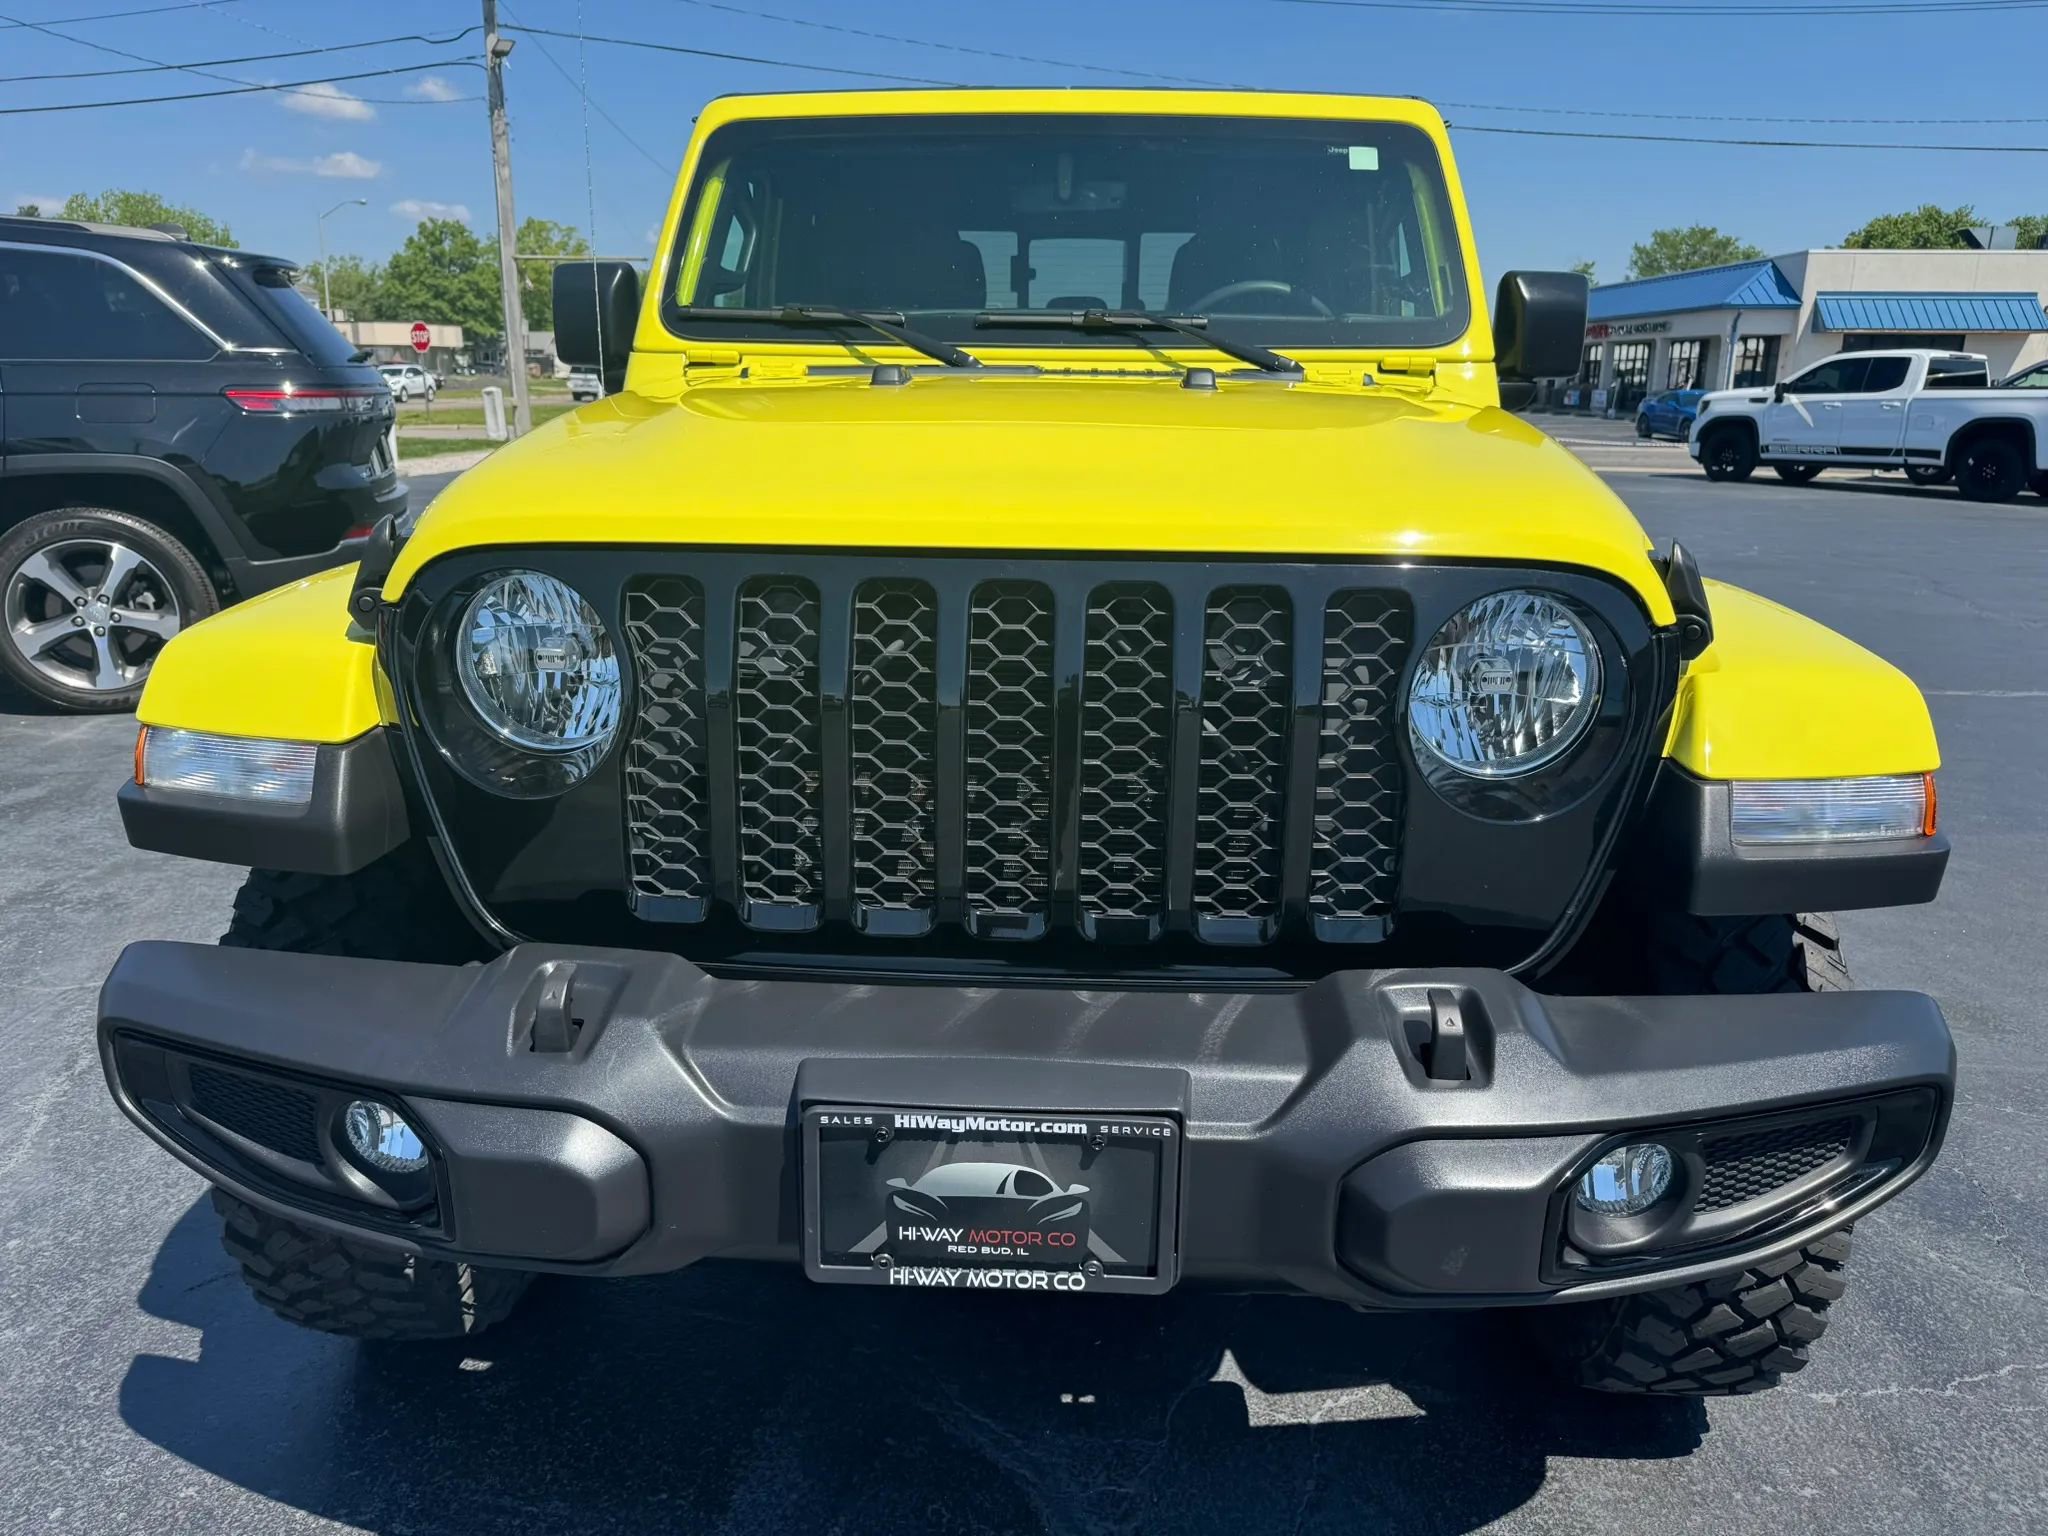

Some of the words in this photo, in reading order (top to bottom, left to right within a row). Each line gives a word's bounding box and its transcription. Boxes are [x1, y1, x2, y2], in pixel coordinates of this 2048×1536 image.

[411, 330, 430, 343] STOP
[820, 1116, 873, 1126] SALES
[894, 1114, 1088, 1135] HiWayMotor.com
[1100, 1125, 1171, 1138] SERVICE
[898, 1226, 964, 1243] HI-WAY
[968, 1229, 1043, 1246] MOTOR
[1047, 1232, 1077, 1247] CO
[947, 1245, 978, 1255] RED
[981, 1247, 1014, 1257] BUD,
[1017, 1247, 1030, 1256] IL
[890, 1267, 963, 1287] HI-WAY
[966, 1270, 1049, 1290] MOTOR
[1053, 1272, 1086, 1291] CO
